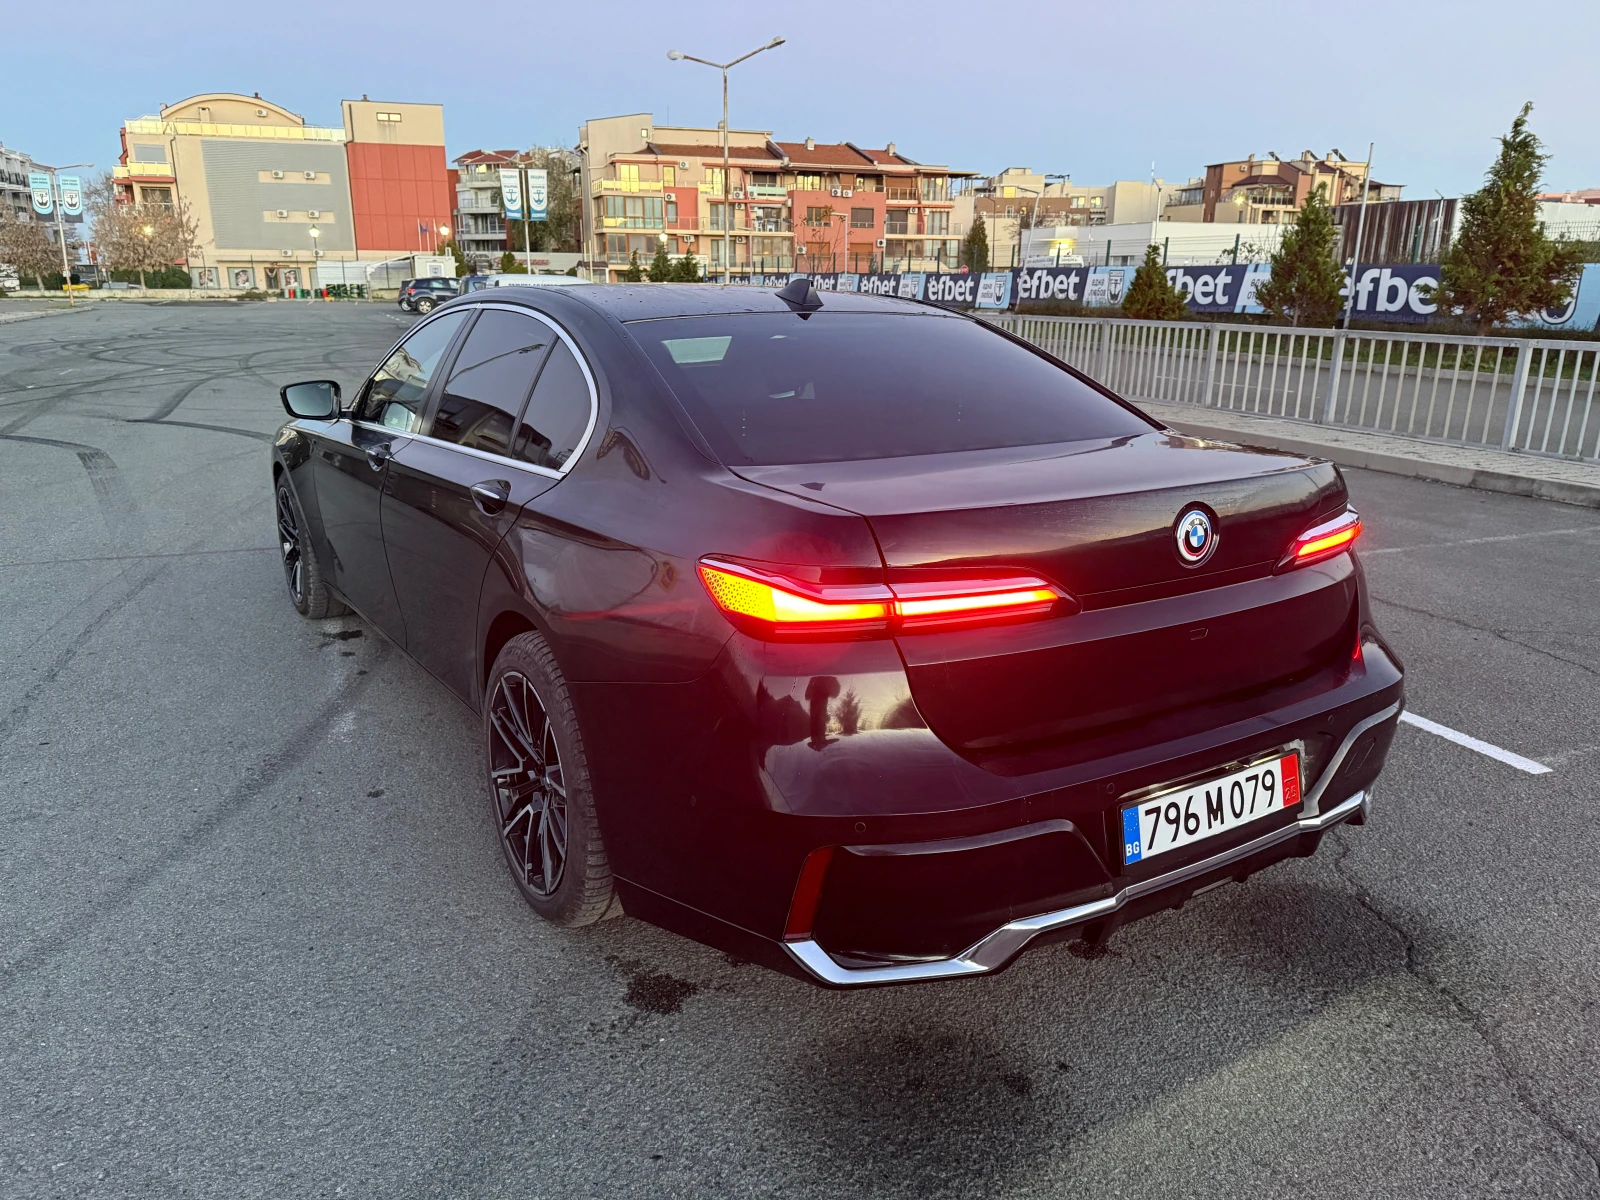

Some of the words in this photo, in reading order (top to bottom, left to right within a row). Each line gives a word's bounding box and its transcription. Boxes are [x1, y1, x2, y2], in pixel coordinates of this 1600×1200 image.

[808, 274, 835, 290] fbet
[860, 275, 896, 295] efbet
[927, 275, 974, 301] efbet
[1018, 267, 1080, 300] efbet
[1166, 267, 1233, 305] fbet
[1338, 267, 1464, 315] efbe
[1145, 795, 1200, 851] 796
[1205, 786, 1225, 830] M
[1230, 769, 1276, 819] 079
[1125, 841, 1140, 857] BG
